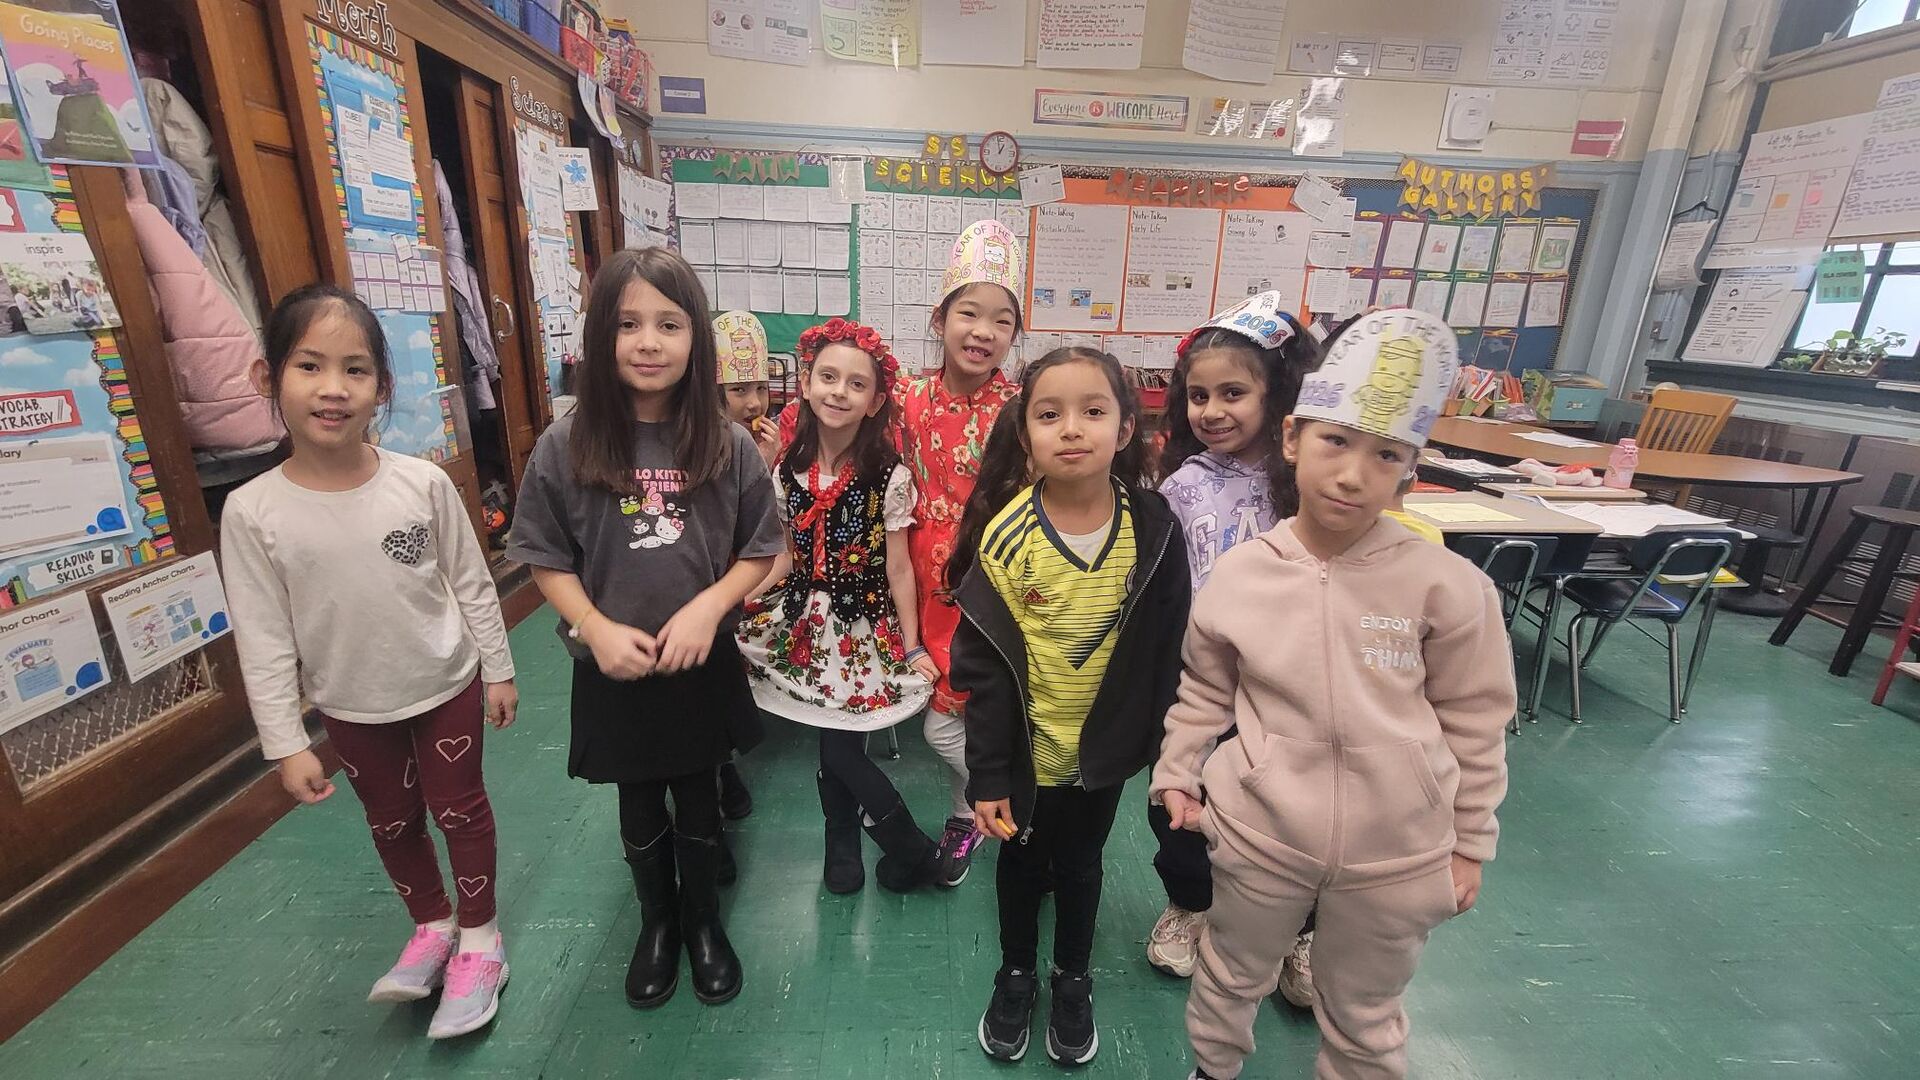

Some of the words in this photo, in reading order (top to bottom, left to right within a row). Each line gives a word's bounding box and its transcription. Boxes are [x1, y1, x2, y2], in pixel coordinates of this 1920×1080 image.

[20, 14, 69, 48] Going
[72, 26, 115, 54] Places
[318, 0, 398, 56] Math
[1042, 97, 1087, 119] Everyone
[1092, 102, 1101, 117] is
[1106, 102, 1154, 119] WELCOME
[1156, 106, 1182, 120] Here
[714, 152, 796, 176] MATH
[1008, 150, 1015, 158] 3
[1401, 159, 1548, 193] AUTHORS'
[1404, 185, 1534, 213] GALLERY
[1039, 206, 1075, 220] Note-Taking
[1132, 210, 1167, 222] Note-Taking
[1227, 213, 1265, 226] Note-Taking
[1130, 223, 1147, 234] Early
[1149, 225, 1161, 233] Life
[1248, 226, 1258, 237] Up
[25, 242, 64, 256] inspire
[953, 233, 973, 260] YEAR
[973, 224, 988, 235] OF
[991, 224, 1011, 240] THE
[717, 317, 731, 331] OF
[734, 315, 753, 328] THE
[1233, 312, 1289, 345] 2026
[1366, 315, 1395, 335] OF
[0, 399, 42, 414] VOCAB.
[0, 411, 53, 430] TRATEGY
[1191, 505, 1261, 580] GA
[46, 549, 95, 574] READING
[56, 564, 95, 585] SKILLS
[108, 586, 141, 604] Reading
[142, 574, 169, 590] Anchor
[170, 564, 195, 578] Charts
[22, 607, 61, 624] Charts
[1359, 615, 1412, 632] ENJOY
[7, 639, 49, 661] EVALUATE
